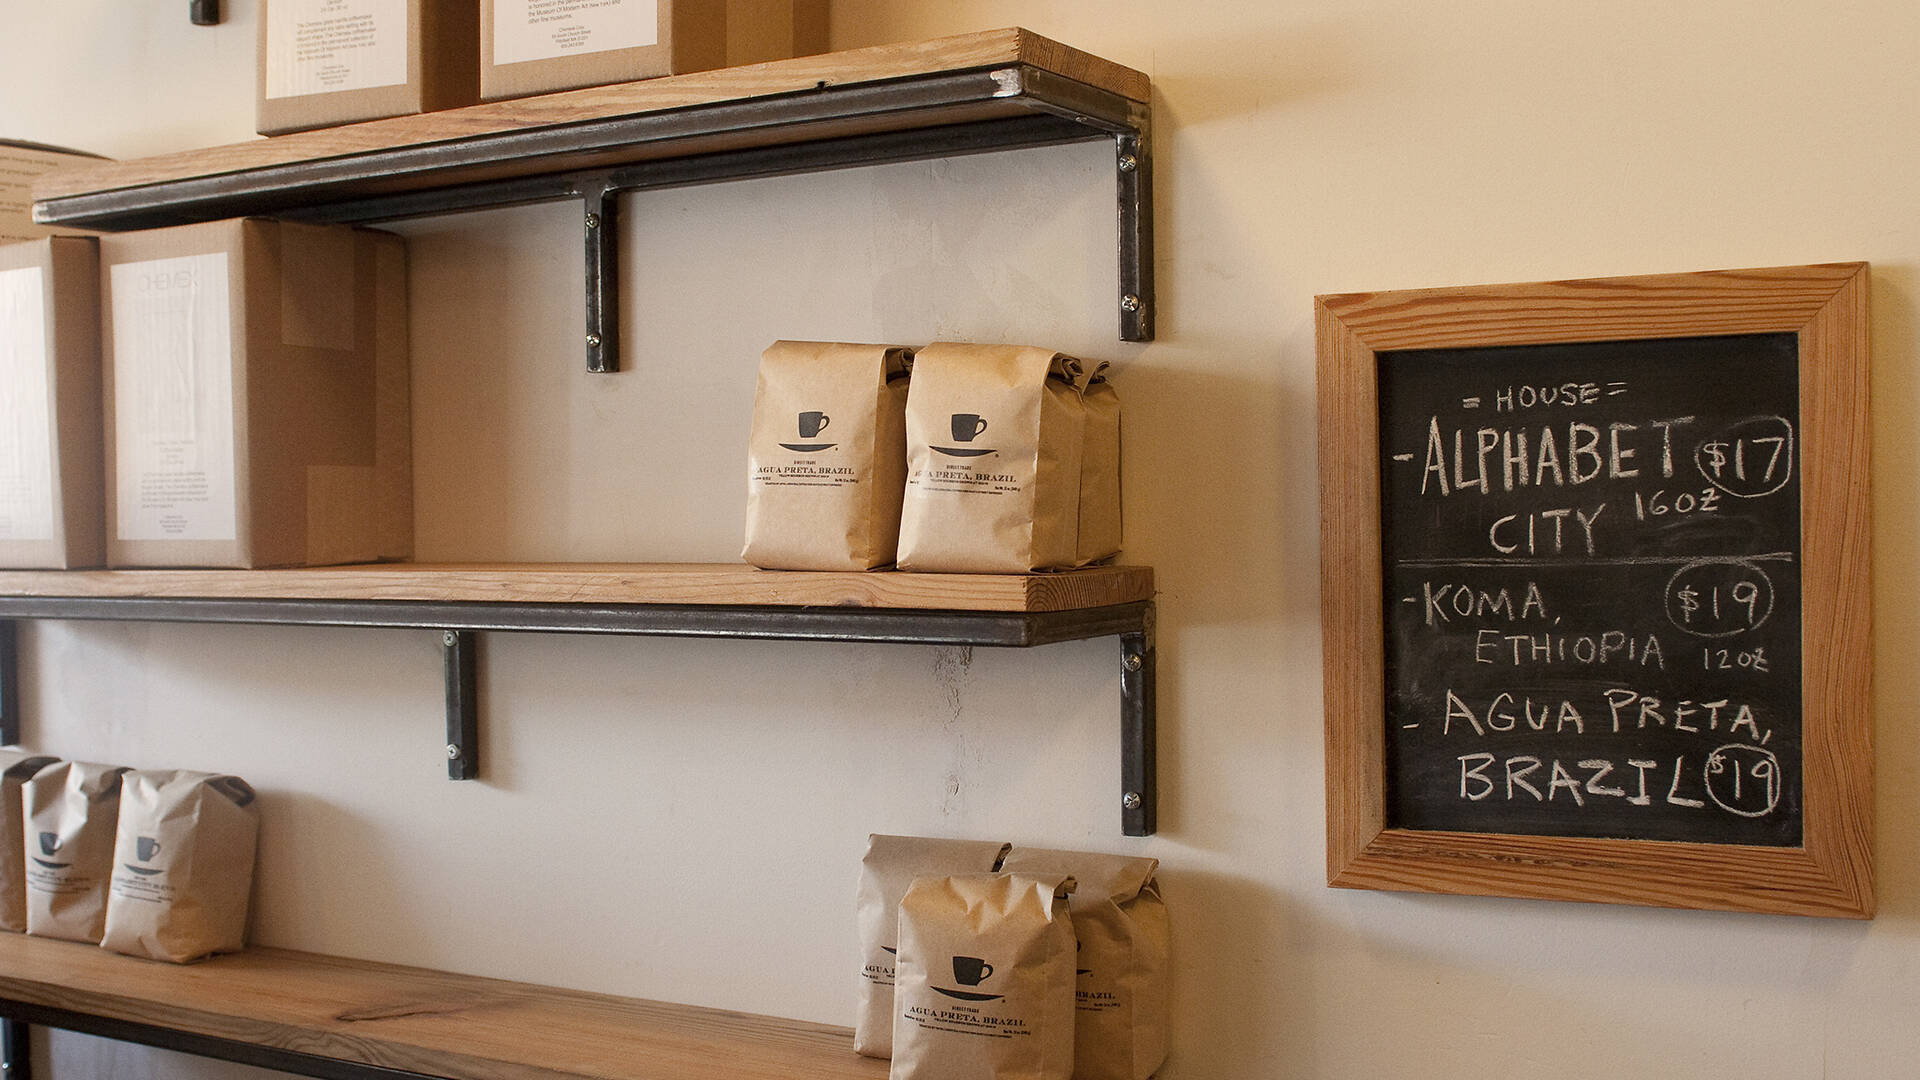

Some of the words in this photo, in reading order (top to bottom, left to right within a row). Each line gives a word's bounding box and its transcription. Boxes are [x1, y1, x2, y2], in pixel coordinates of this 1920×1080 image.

[1496, 382, 1601, 413] HOUSE
[757, 466, 782, 474] AGUA
[818, 467, 855, 475] BRAZIL
[975, 473, 1017, 483] BRAZIL
[1703, 435, 1786, 483] $17
[1488, 502, 1607, 557] CITY
[1677, 580, 1759, 625] $19
[1475, 629, 1665, 671] ETHIOPIA
[1443, 688, 1585, 737] AGUA
[1602, 688, 1772, 746] PRETA,
[1456, 751, 1705, 809] BRAZIL
[1708, 751, 1775, 807] $19
[909, 1006, 938, 1017] AGUA
[983, 1016, 1026, 1027] BRAZIL
